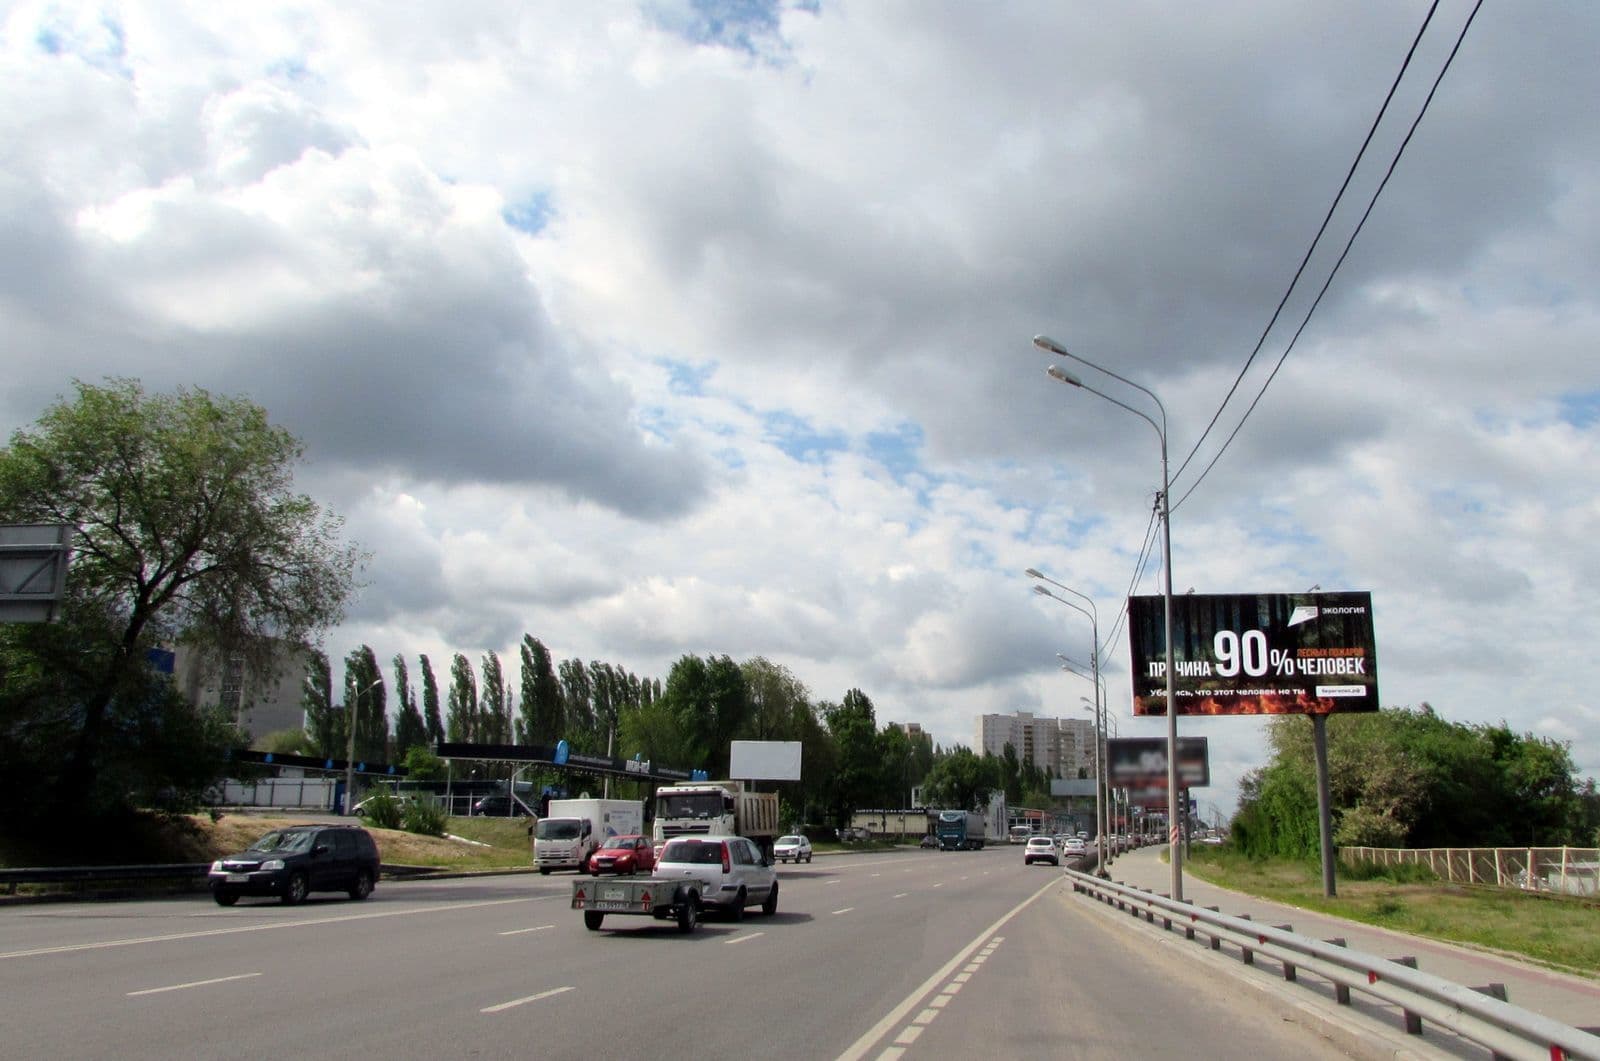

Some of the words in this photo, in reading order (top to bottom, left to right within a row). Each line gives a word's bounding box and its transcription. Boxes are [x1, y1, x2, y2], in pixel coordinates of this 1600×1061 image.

[1149, 661, 1211, 677] ПРЧИНА
[1297, 657, 1365, 675] ЧЕЛОВЕК
[1150, 688, 1194, 697] Убеись,
[1236, 688, 1276, 696] человек
